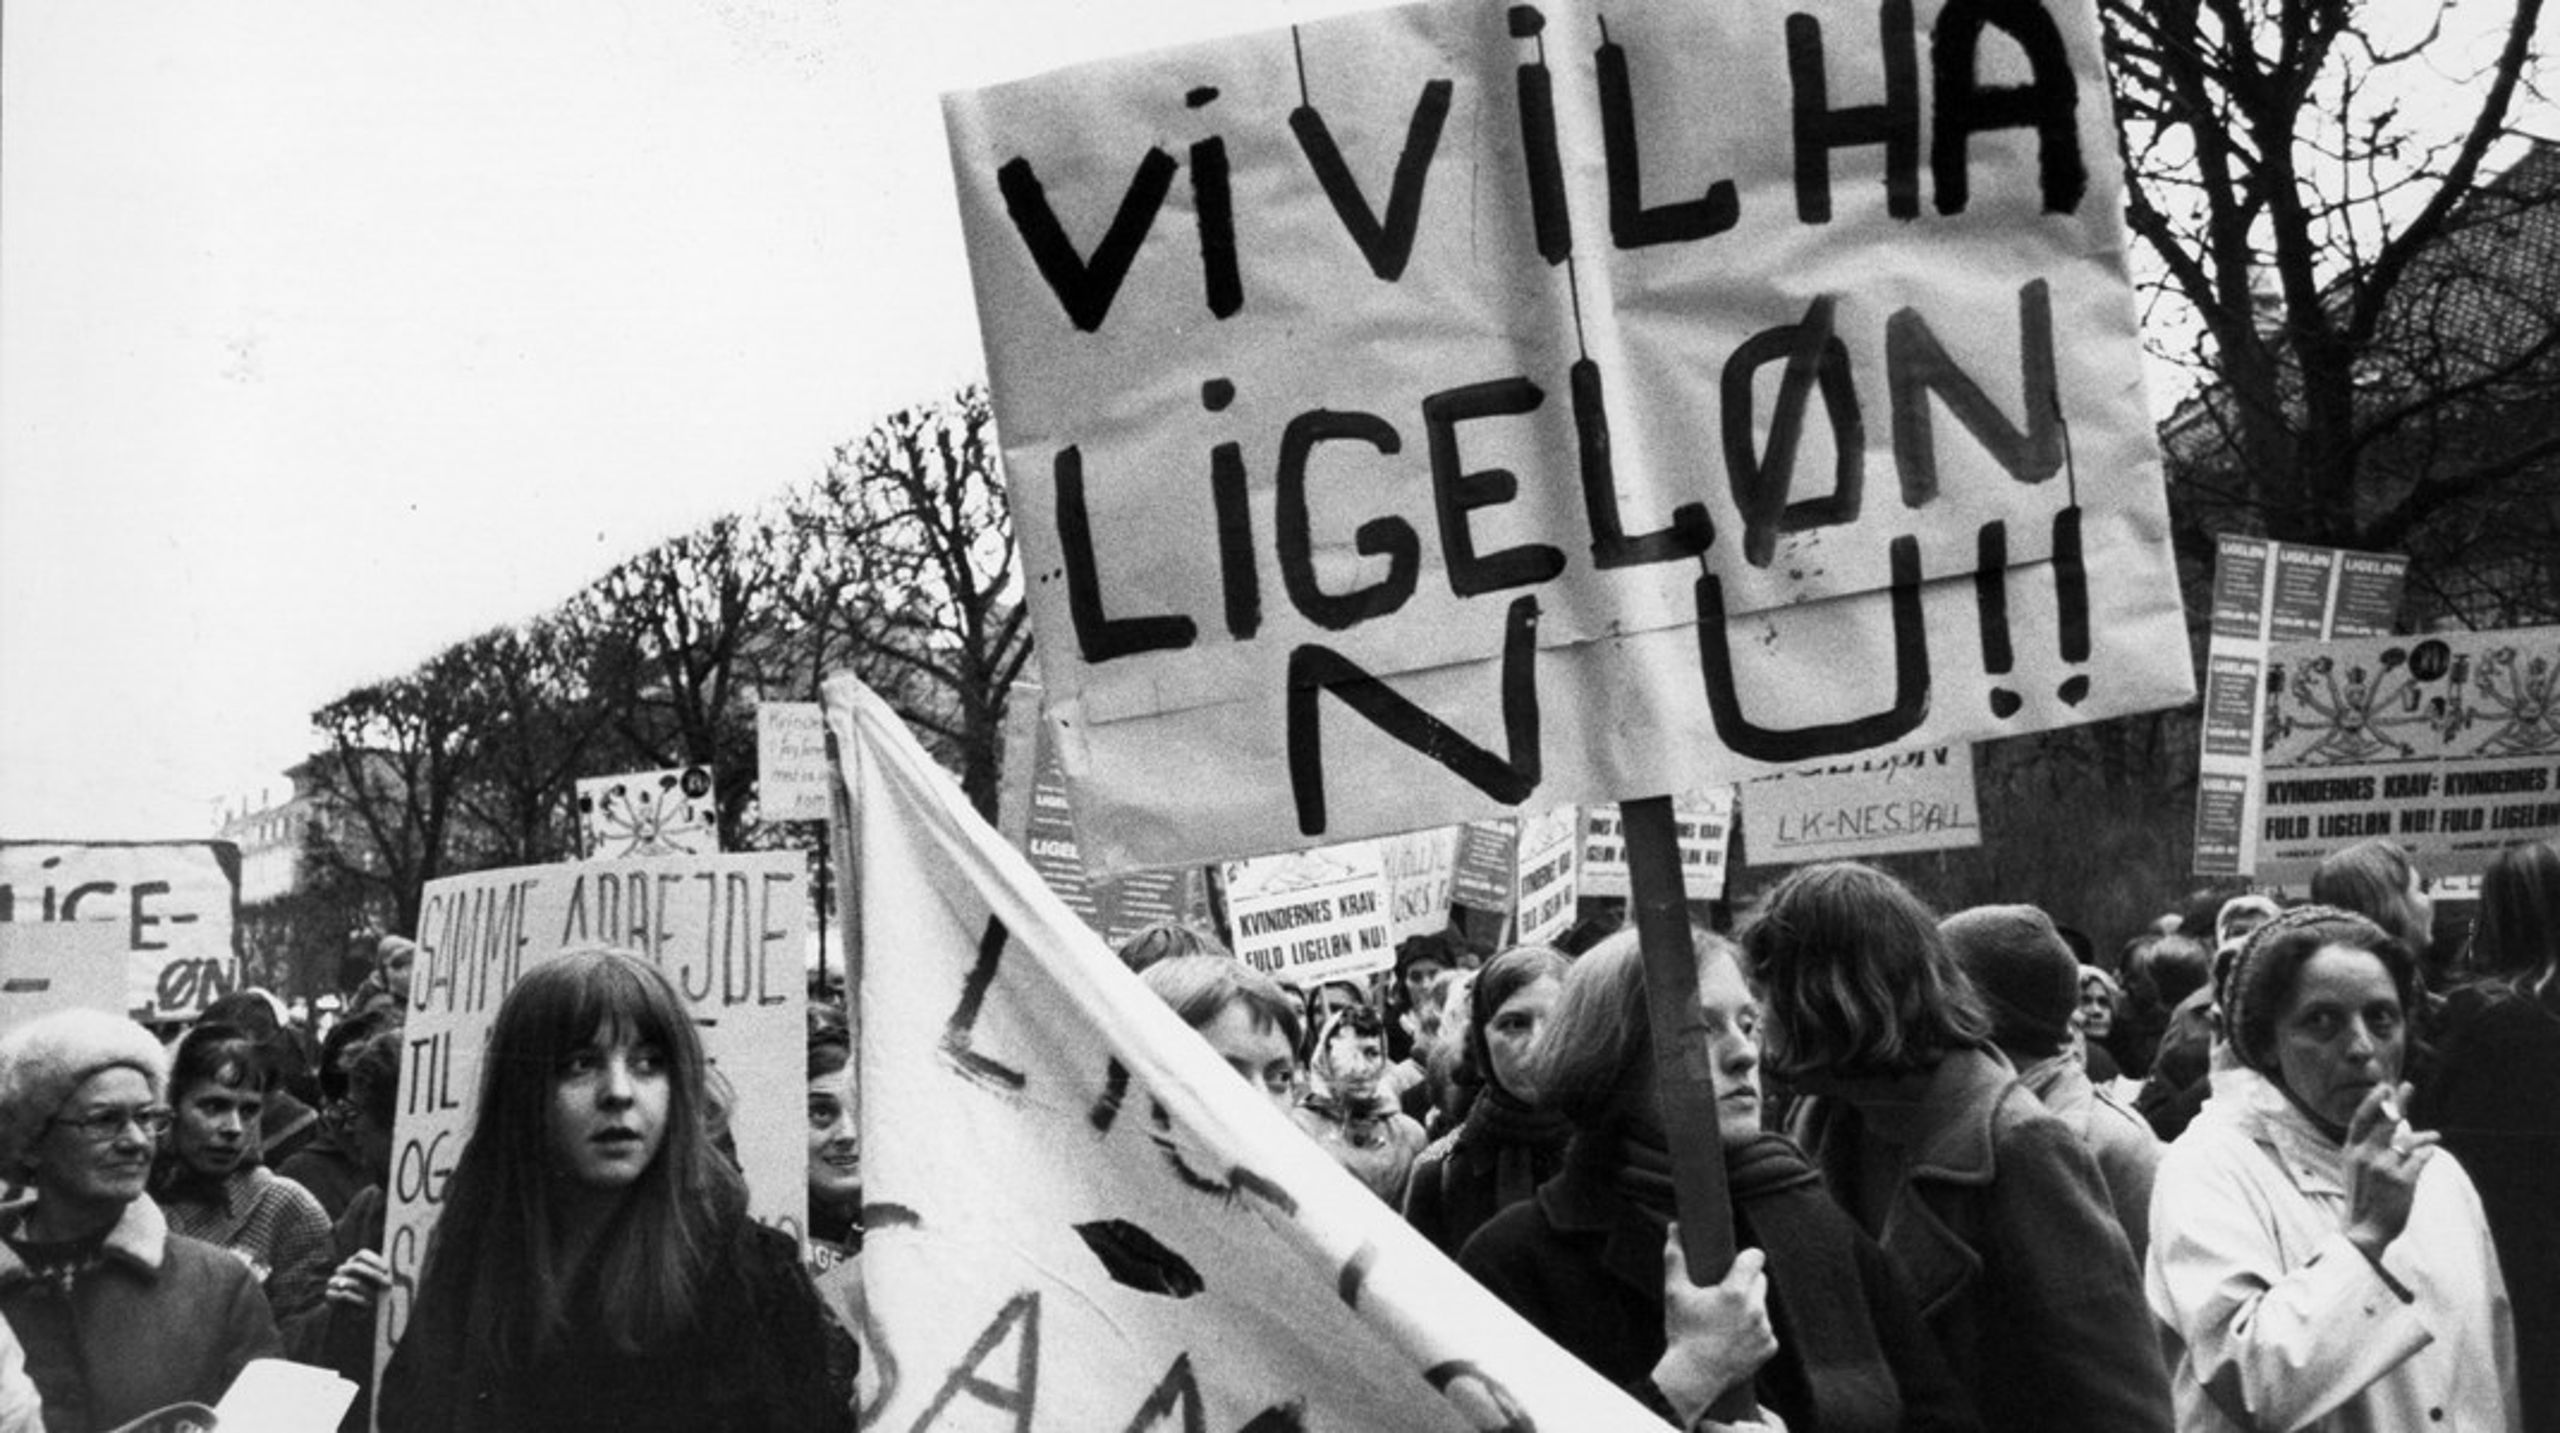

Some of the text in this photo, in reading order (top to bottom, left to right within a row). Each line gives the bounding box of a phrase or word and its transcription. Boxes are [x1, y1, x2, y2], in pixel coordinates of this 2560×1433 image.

[1788, 0, 2089, 225] HA
[2266, 773, 2440, 806] KVINDERNES KRAV:
[2443, 767, 2549, 797] KVINDERNES
[2265, 807, 2435, 841] FULD LIGELØN NU!
[2440, 806, 2485, 832] FULD
[1237, 898, 1333, 938] KVINDERNES
[1290, 932, 1354, 965] LIGELØN
[1358, 925, 1388, 950] NU!
[408, 1030, 460, 1116] TIL
